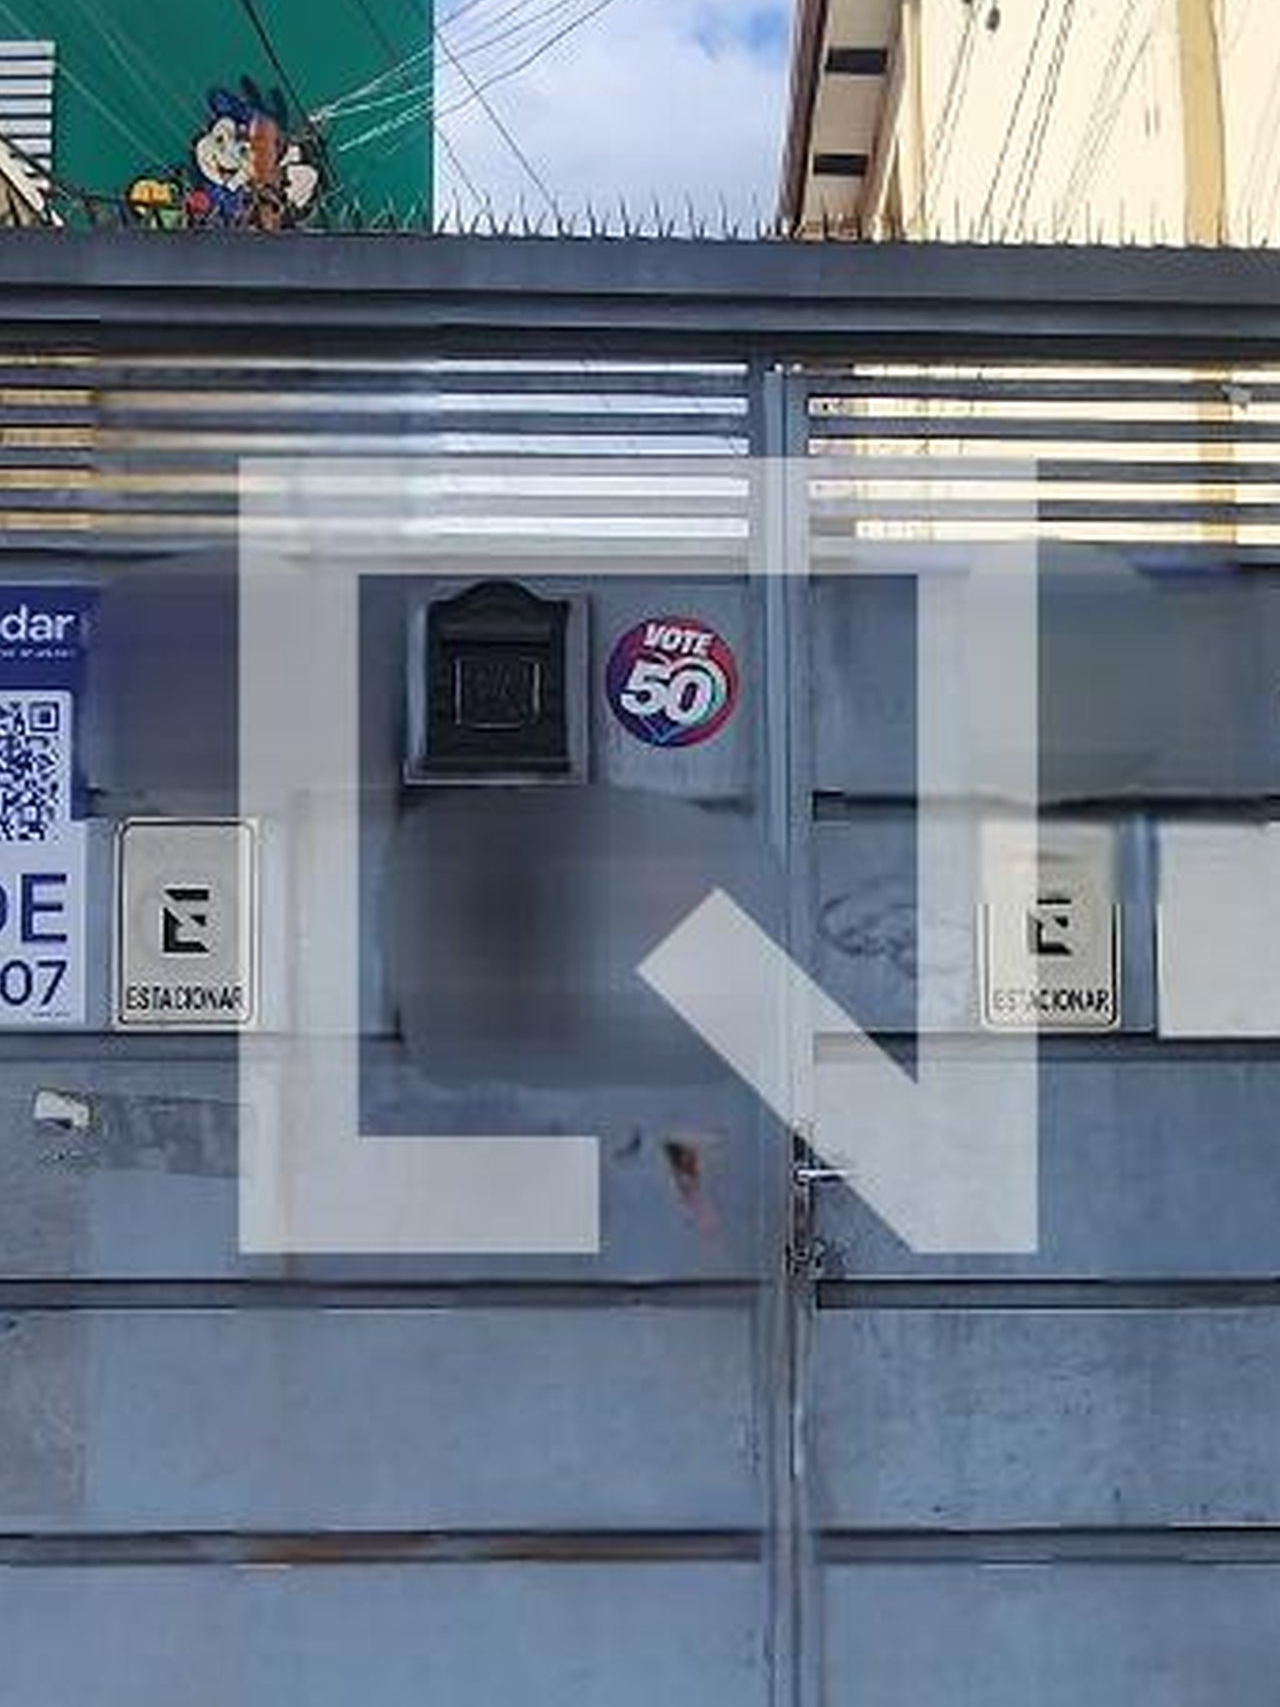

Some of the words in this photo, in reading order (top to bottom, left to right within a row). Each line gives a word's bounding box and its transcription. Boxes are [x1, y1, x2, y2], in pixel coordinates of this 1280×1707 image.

[644, 624, 715, 657] VOTE
[620, 656, 726, 726] 50
[126, 985, 243, 1011] ESTACIONAR
